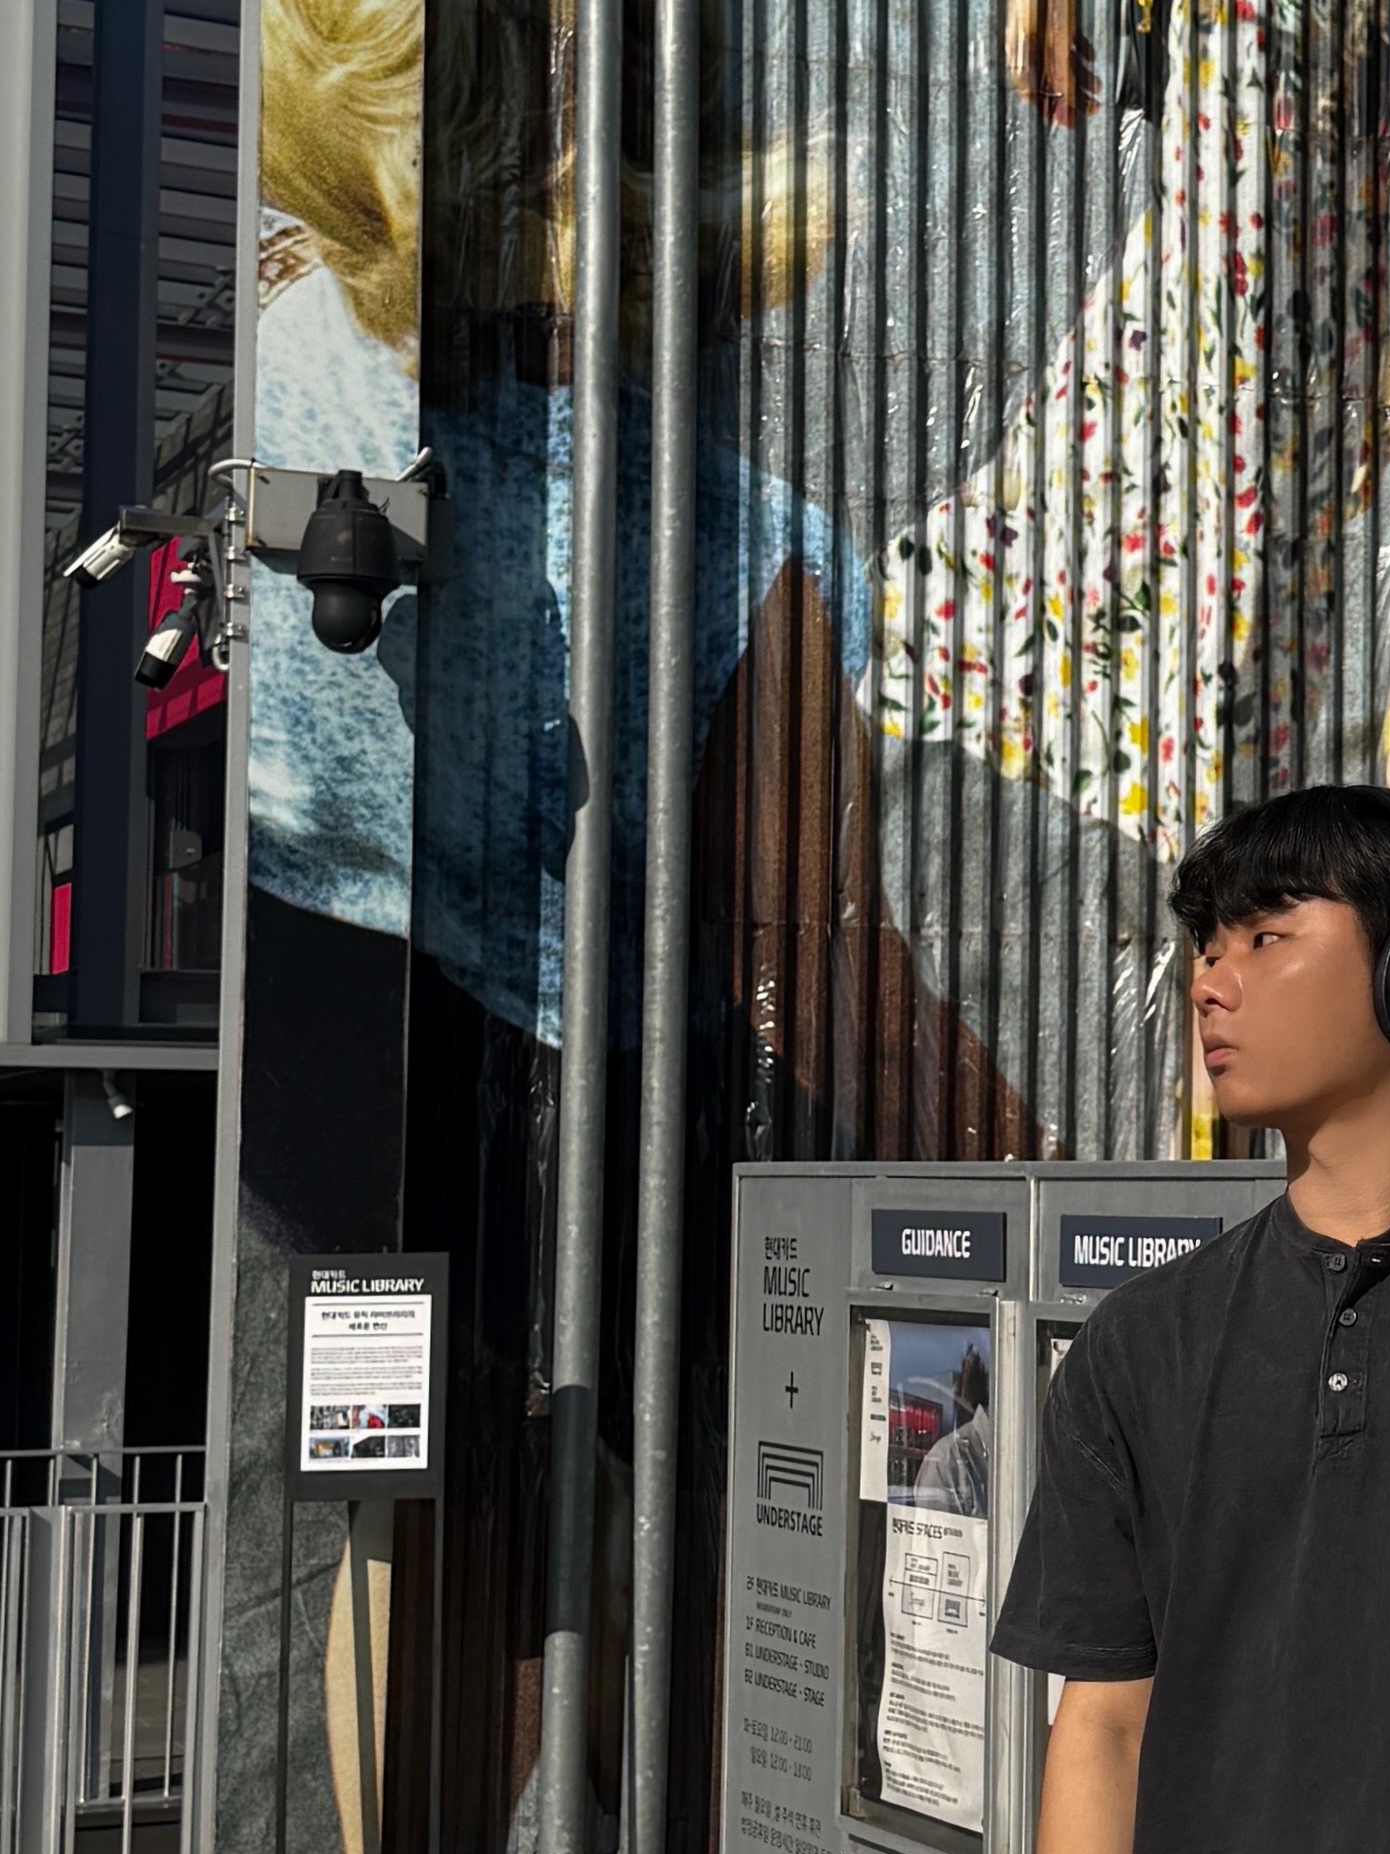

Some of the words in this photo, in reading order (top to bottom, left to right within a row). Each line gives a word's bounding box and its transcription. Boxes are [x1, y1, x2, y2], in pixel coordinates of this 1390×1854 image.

[901, 1228, 971, 1259] GUIDANCE
[1074, 1235, 1125, 1267] MUSIC
[311, 1279, 360, 1294] MUSIC
[361, 1278, 425, 1293] LIBRARY
[763, 1265, 811, 1298] MUSIC
[763, 1302, 825, 1337] LIBRARY
[756, 1503, 824, 1537] UNDERSTAGE
